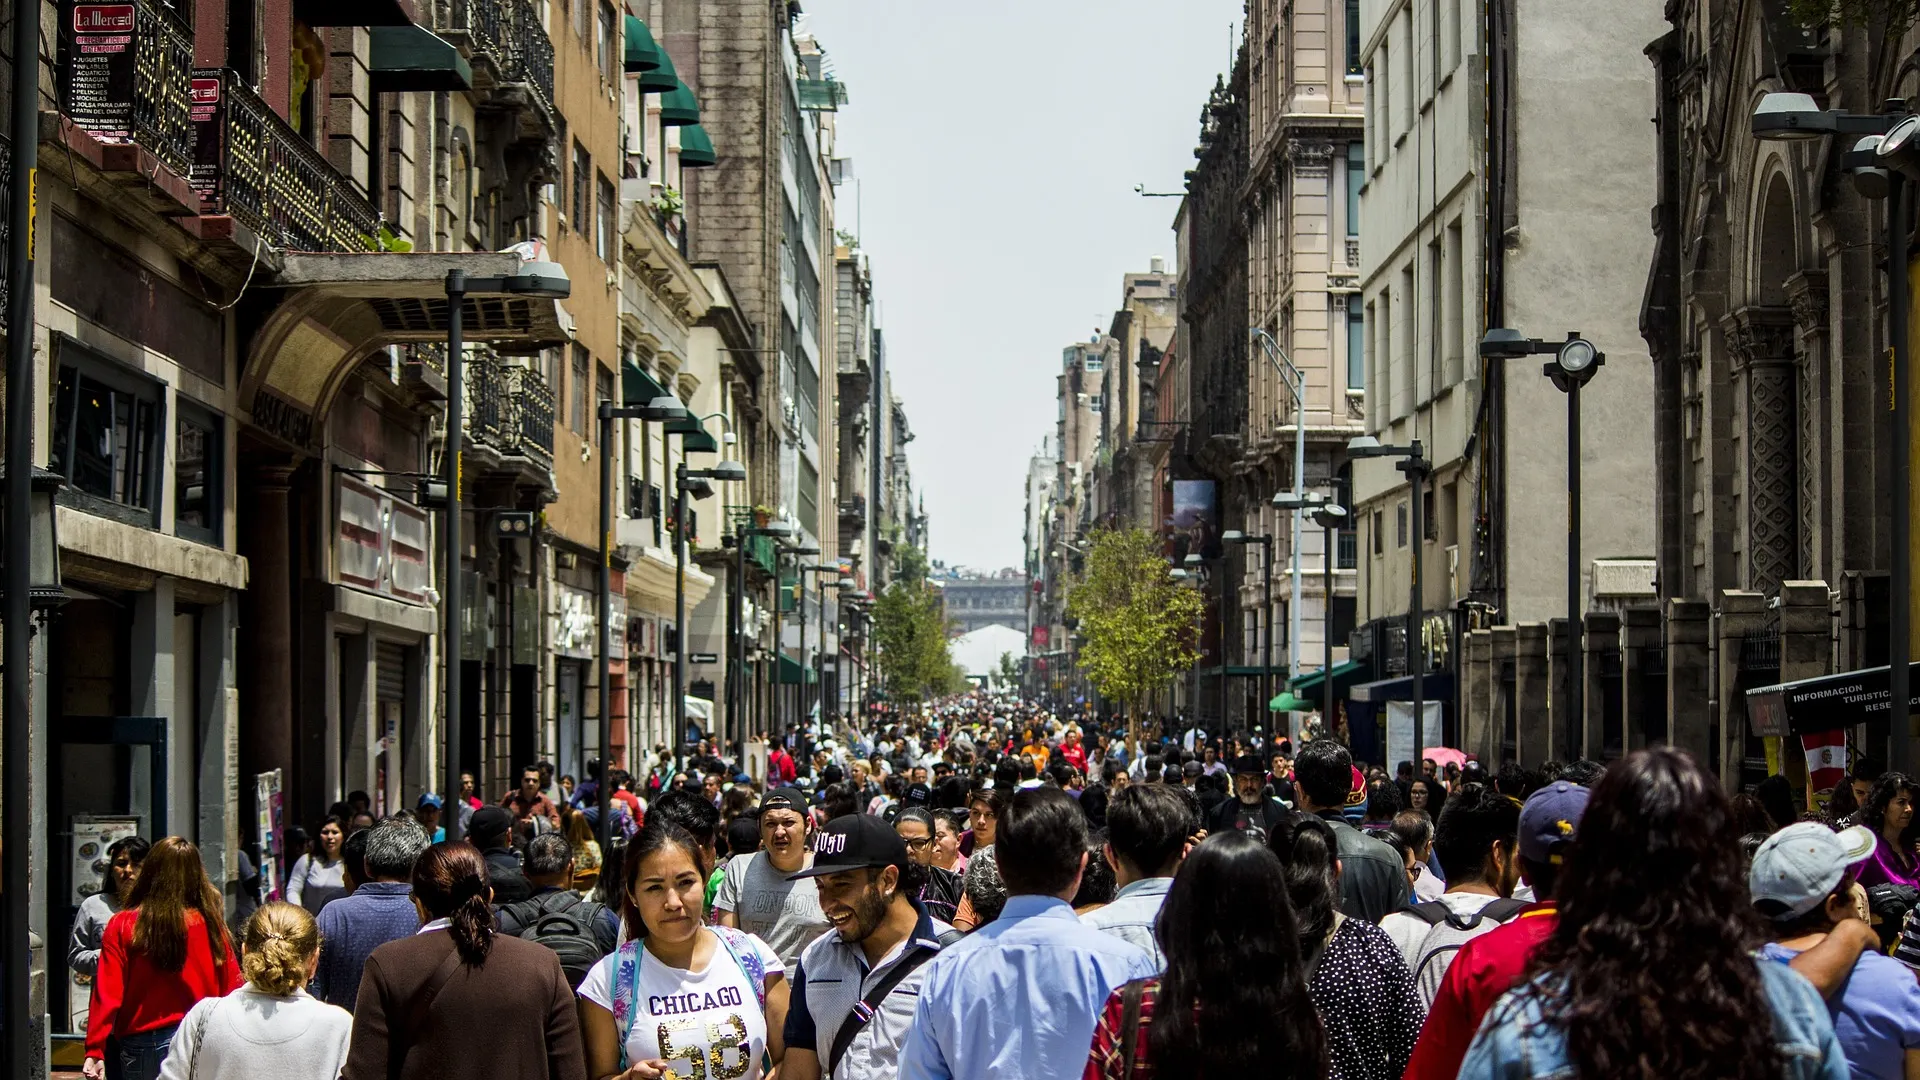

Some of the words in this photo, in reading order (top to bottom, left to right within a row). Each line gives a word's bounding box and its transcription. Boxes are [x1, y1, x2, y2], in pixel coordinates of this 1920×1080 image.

[77, 13, 90, 26] La
[1793, 684, 1863, 703] INFORMACION
[648, 986, 743, 1016] CHICAGO
